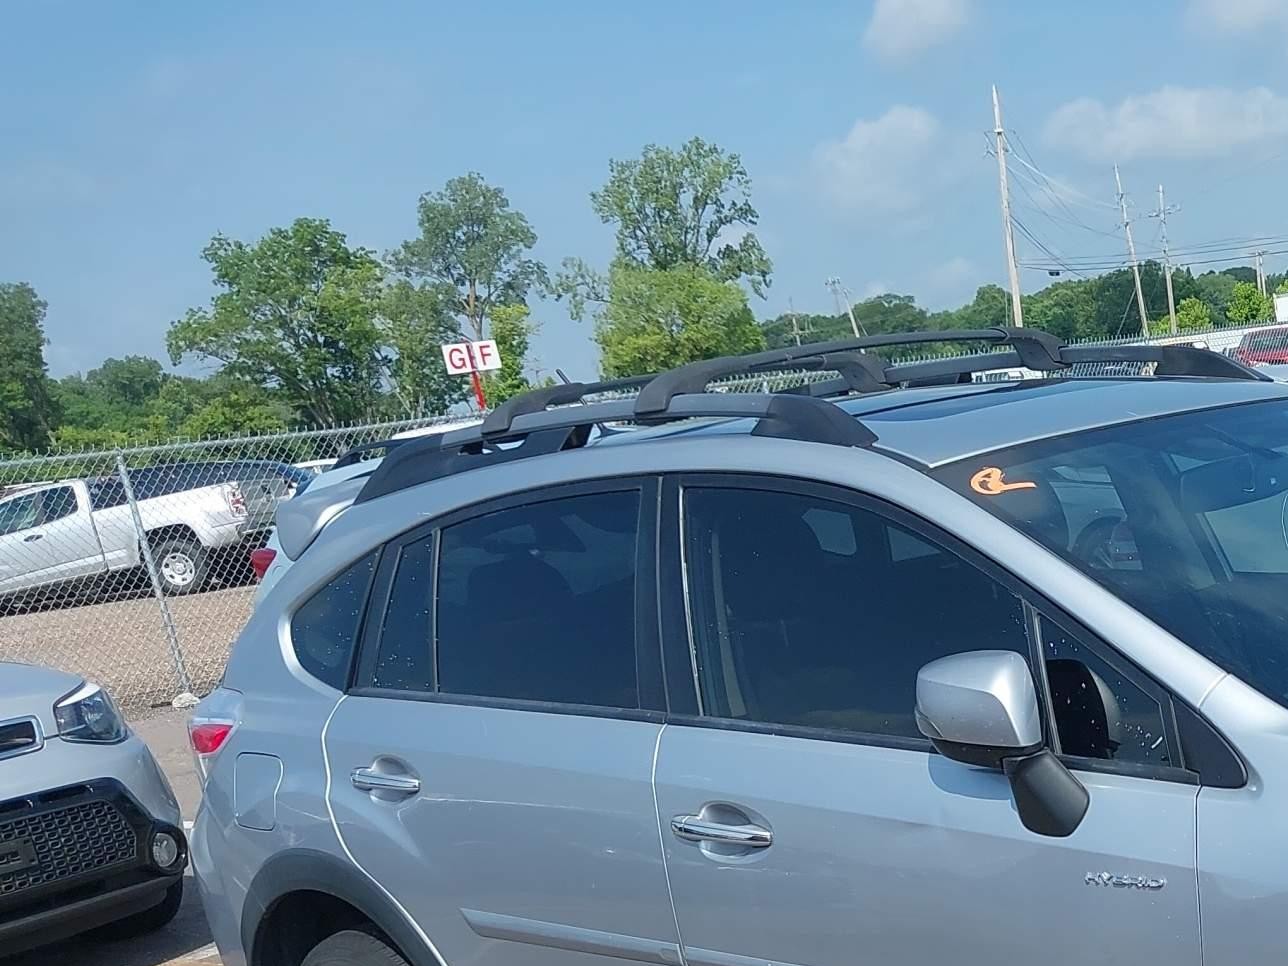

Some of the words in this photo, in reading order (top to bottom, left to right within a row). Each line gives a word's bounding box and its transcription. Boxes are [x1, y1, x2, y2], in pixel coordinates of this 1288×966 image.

[449, 348, 467, 369] G
[479, 345, 491, 366] F
[1084, 871, 1167, 890] HYBRID
